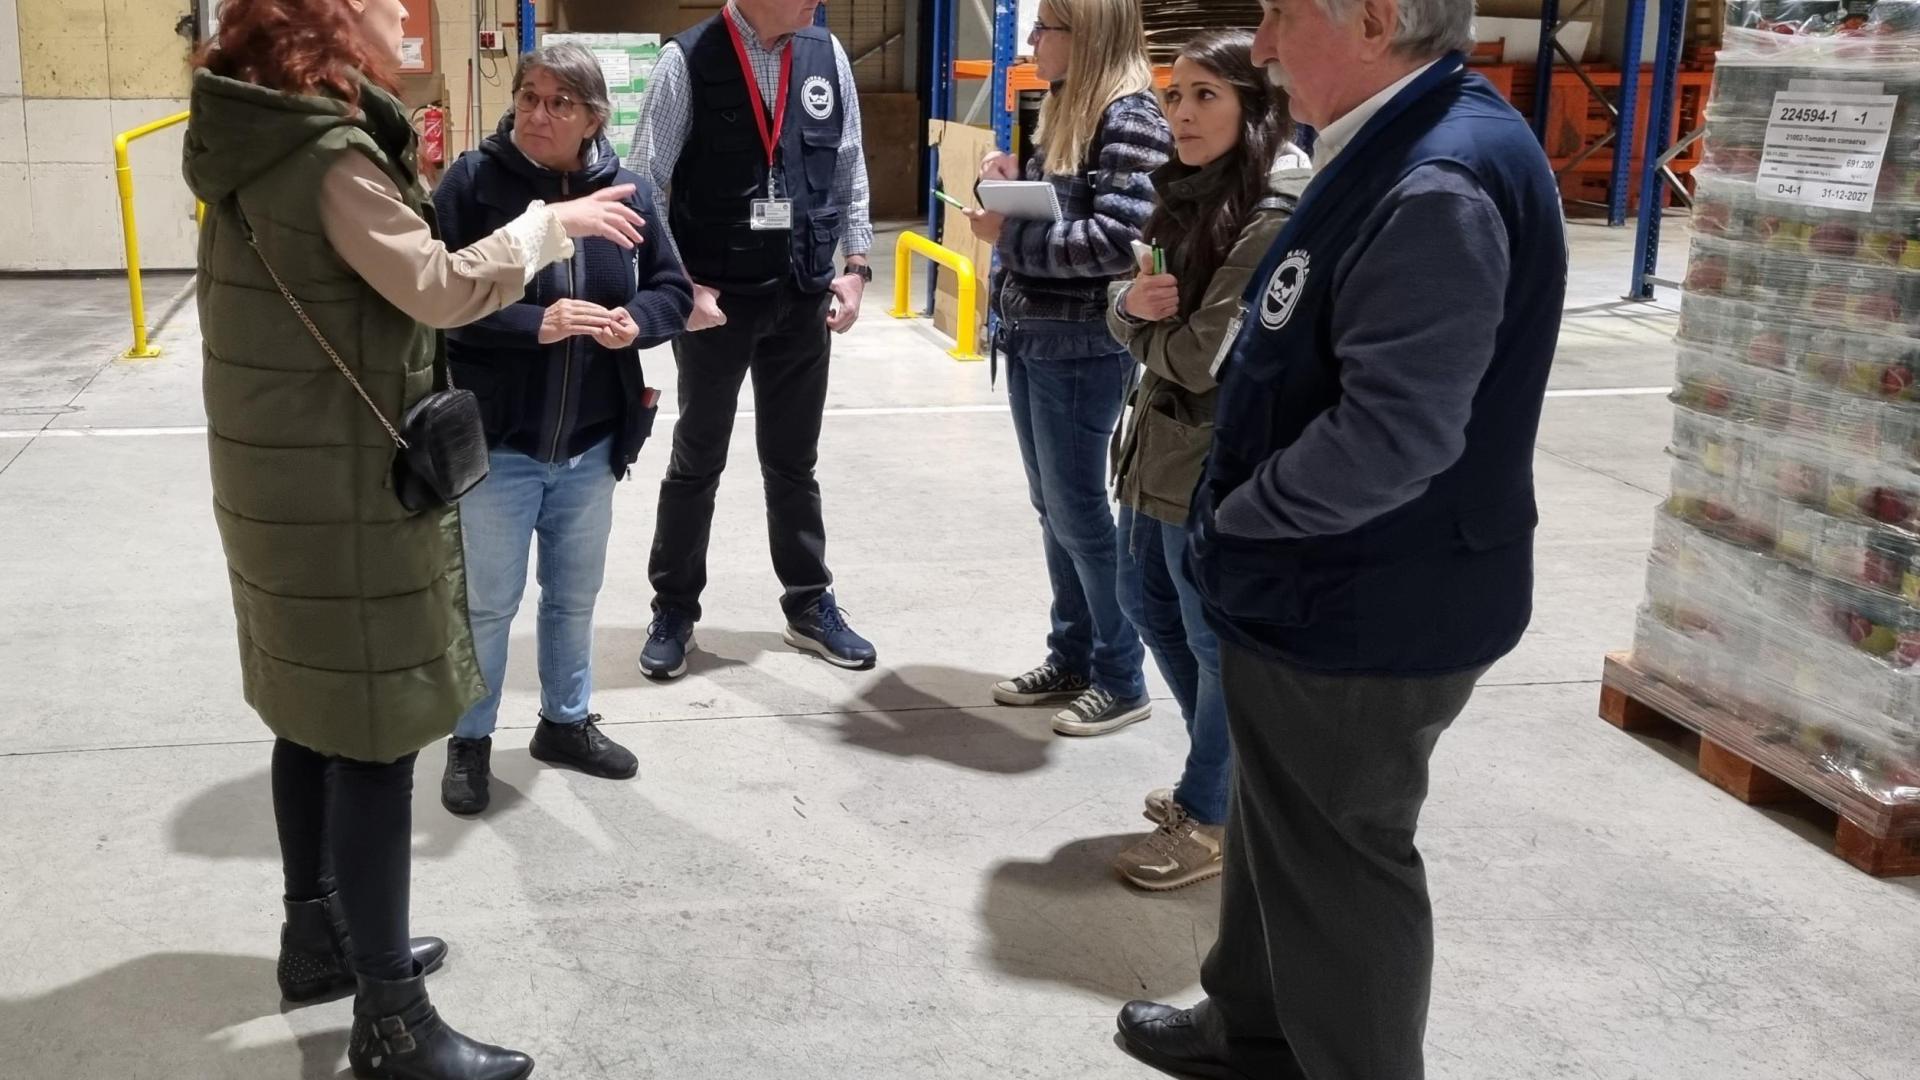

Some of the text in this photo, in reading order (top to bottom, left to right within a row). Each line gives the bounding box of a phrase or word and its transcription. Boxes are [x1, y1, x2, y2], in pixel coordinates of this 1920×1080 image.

[1780, 107, 1868, 125] 224594-1 -1
[1777, 184, 1868, 202] D-4-1 31-12-2027
